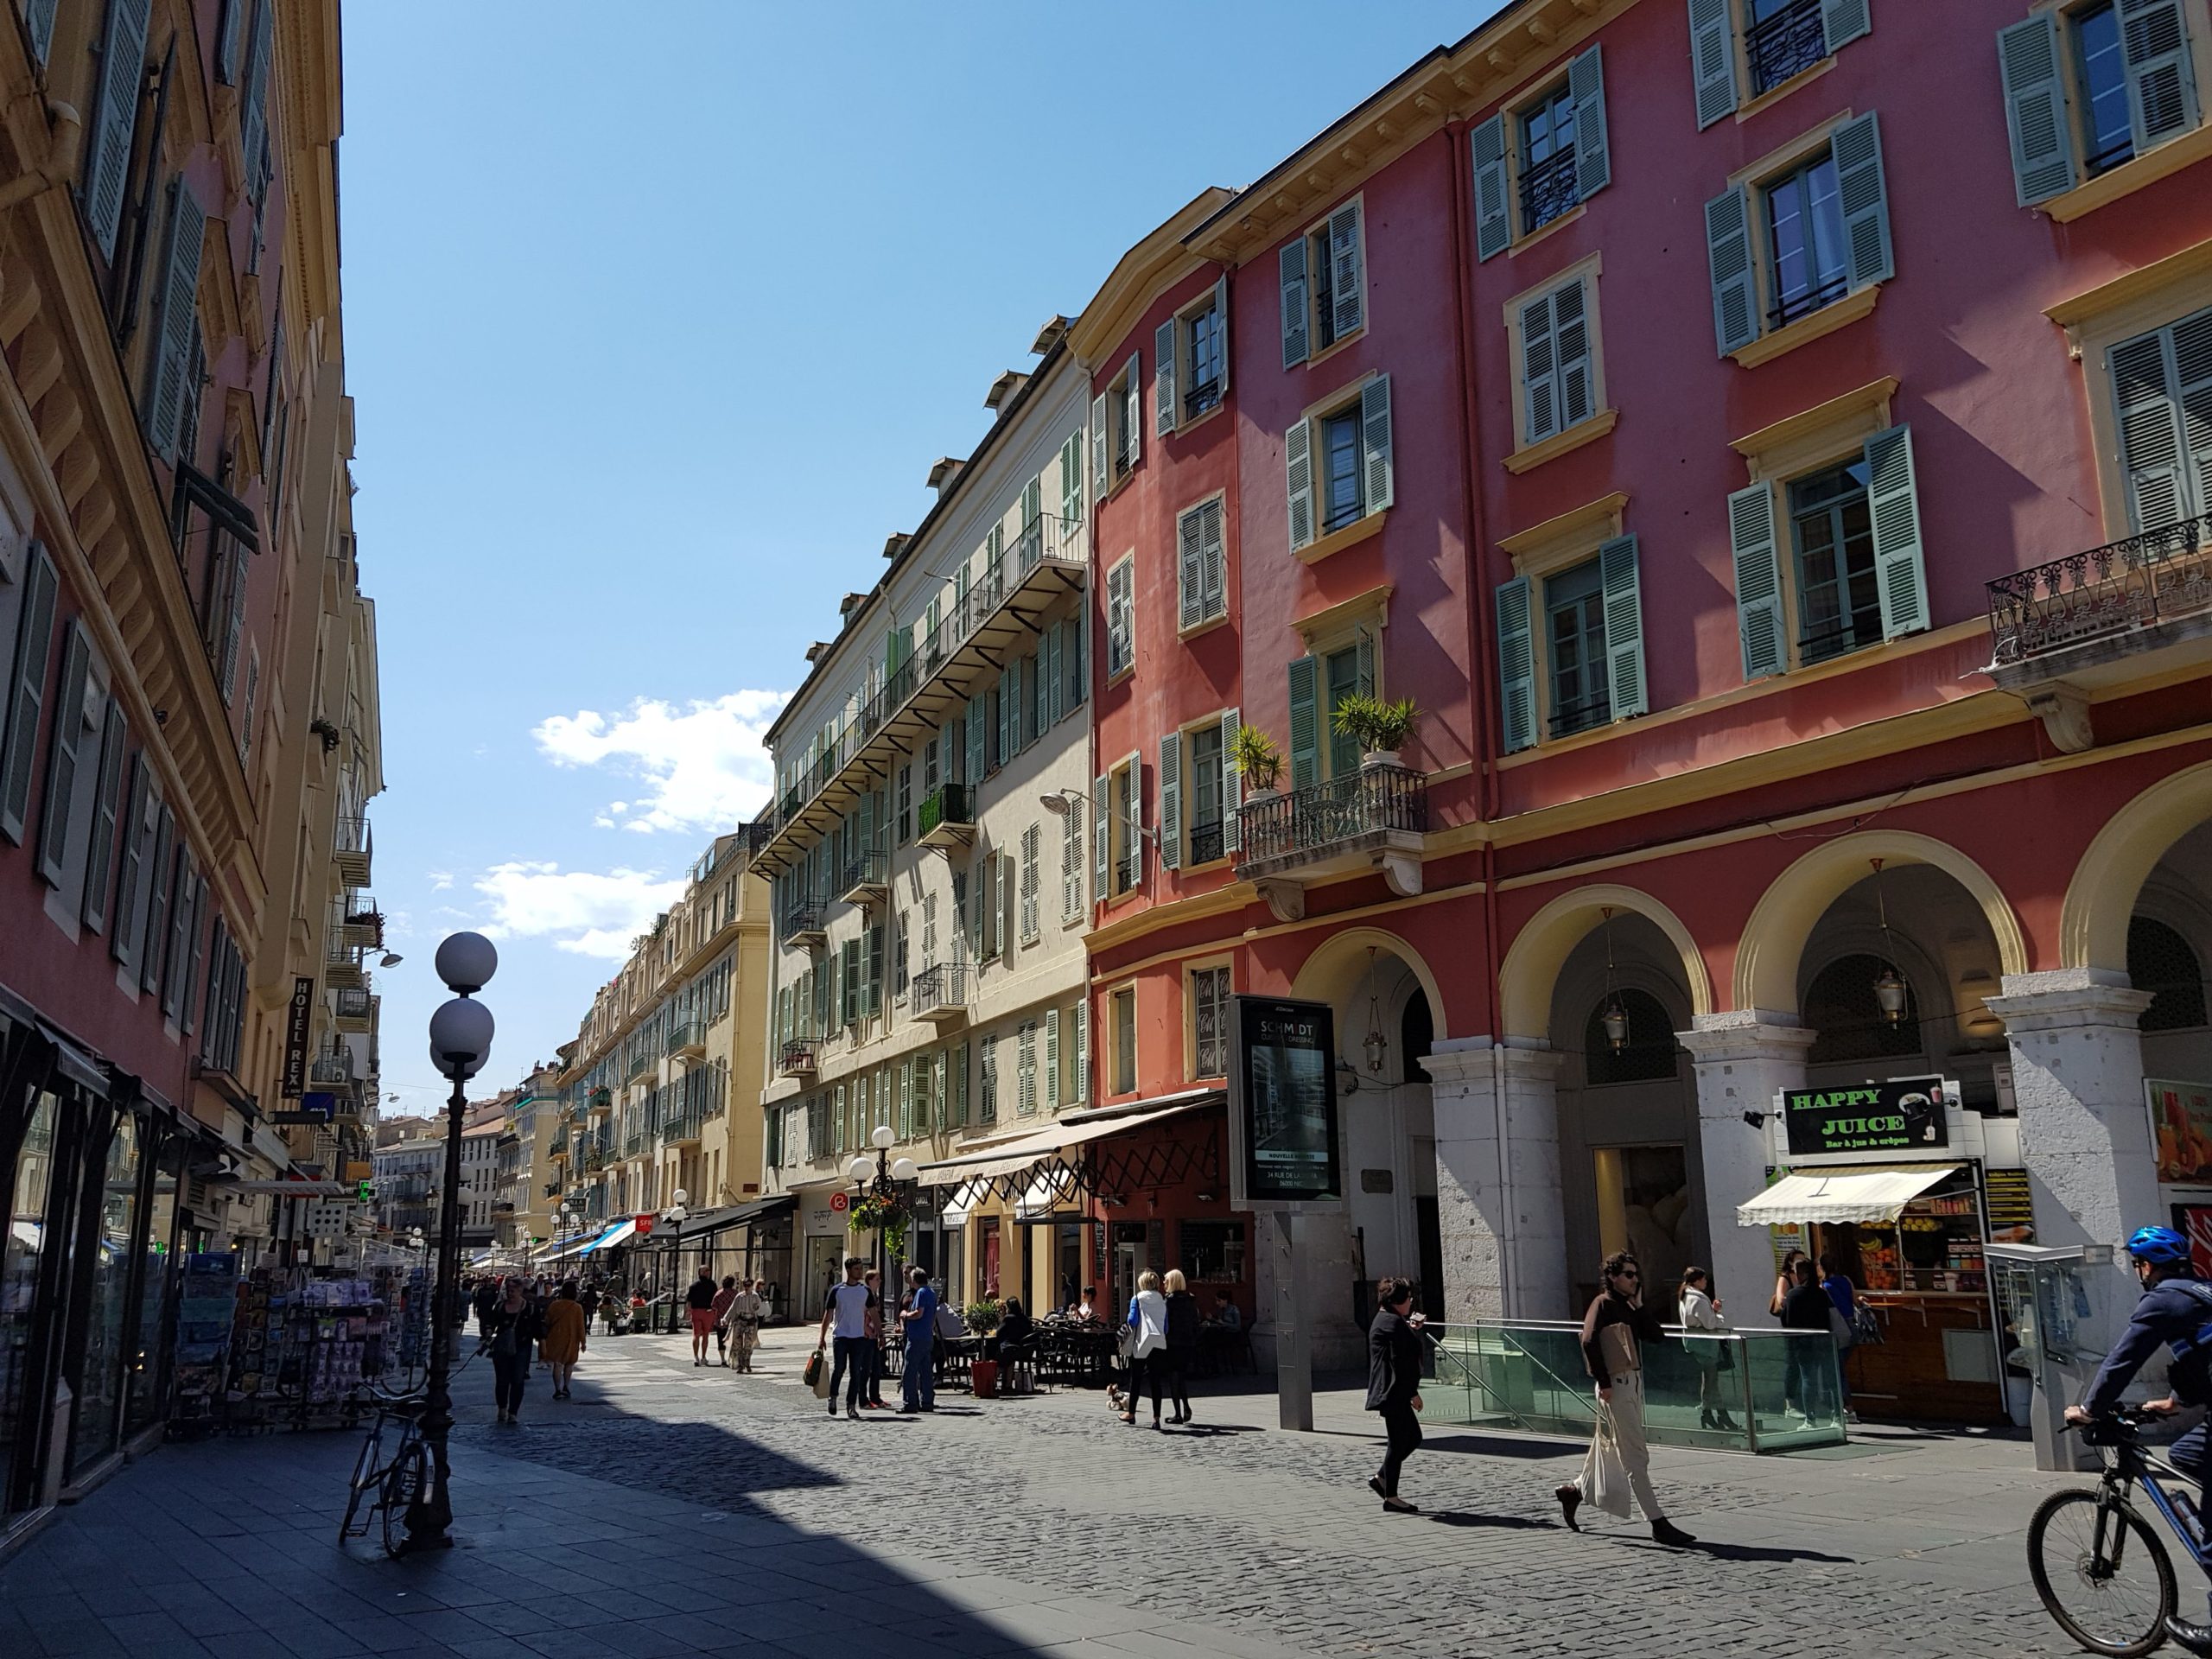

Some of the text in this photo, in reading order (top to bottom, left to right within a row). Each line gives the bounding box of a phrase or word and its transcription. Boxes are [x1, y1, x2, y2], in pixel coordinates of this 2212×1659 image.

[289, 982, 308, 1085] HOTEL REX
[1262, 1020, 1313, 1036] SCHMIDT
[1791, 1089, 1882, 1110] HAPPY
[1821, 1116, 1906, 1135] JUICE
[1825, 1140, 1842, 1148] Bar
[1852, 1139, 1867, 1148] jus
